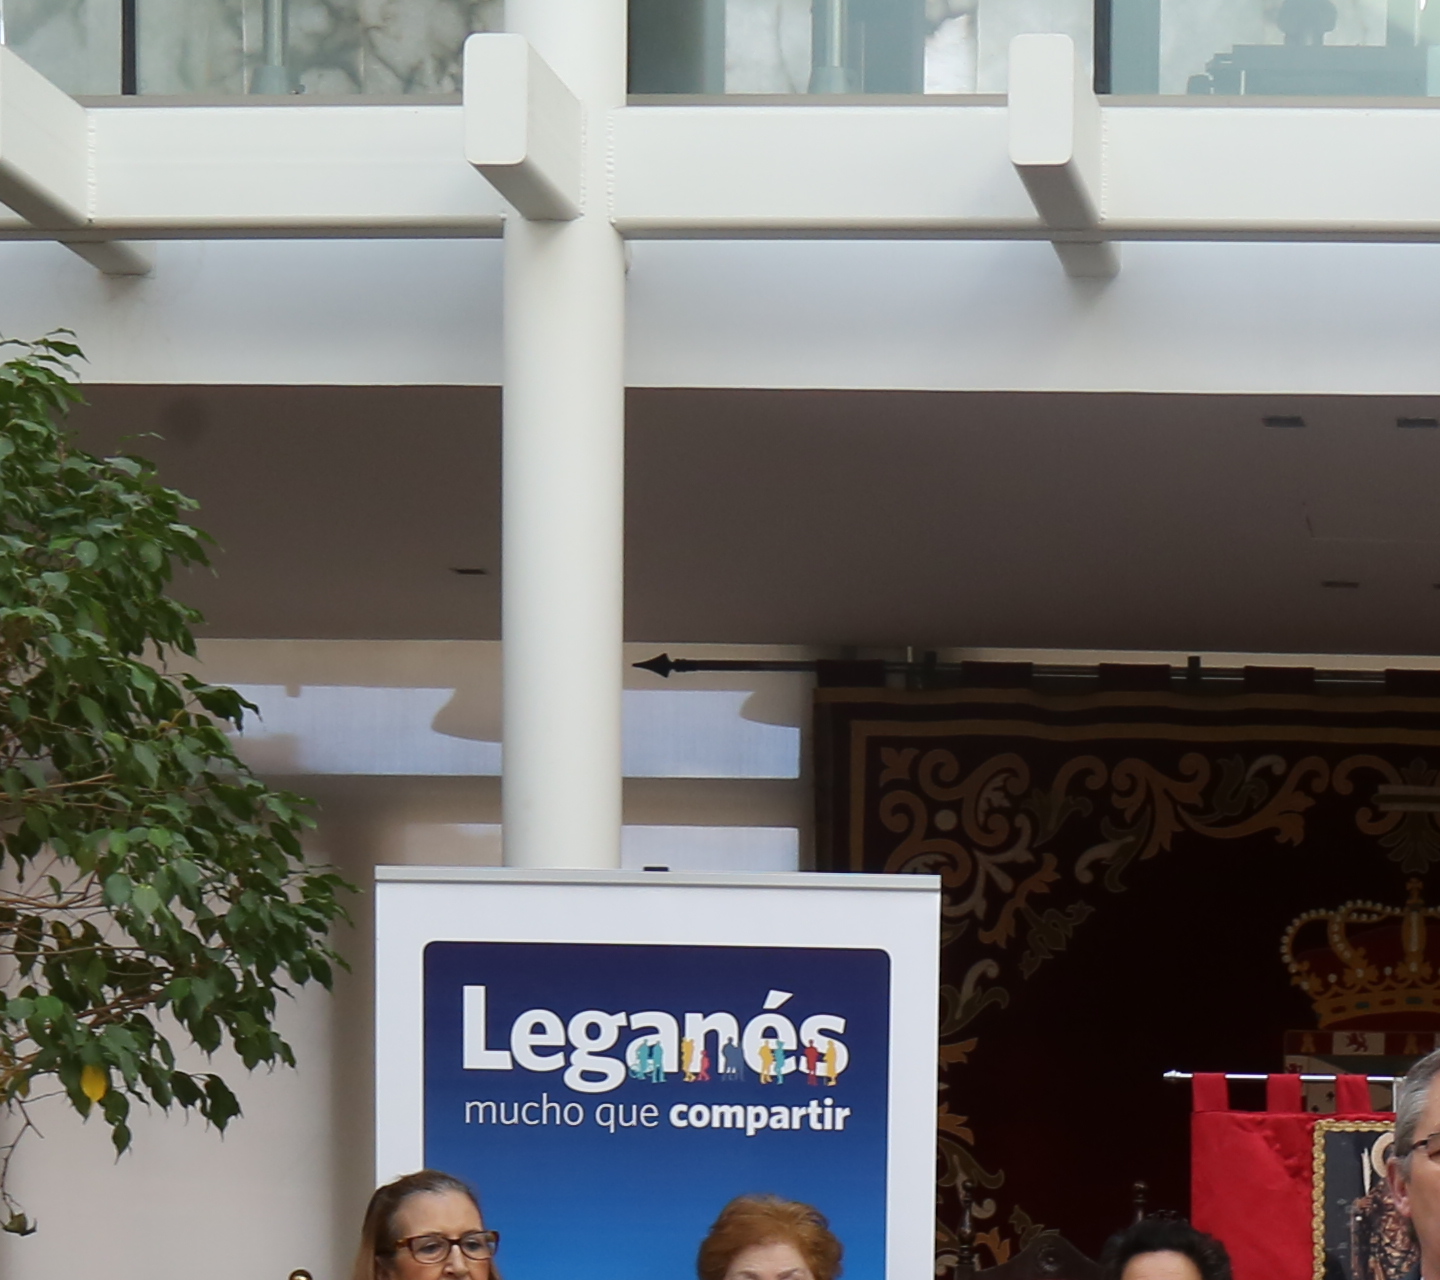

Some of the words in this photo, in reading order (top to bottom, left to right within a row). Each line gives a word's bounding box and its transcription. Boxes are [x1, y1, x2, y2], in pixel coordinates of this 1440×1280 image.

[462, 985, 849, 1093] Leganés
[464, 1093, 584, 1127] mucho
[595, 1101, 659, 1133] que
[669, 1098, 851, 1136] compartir
